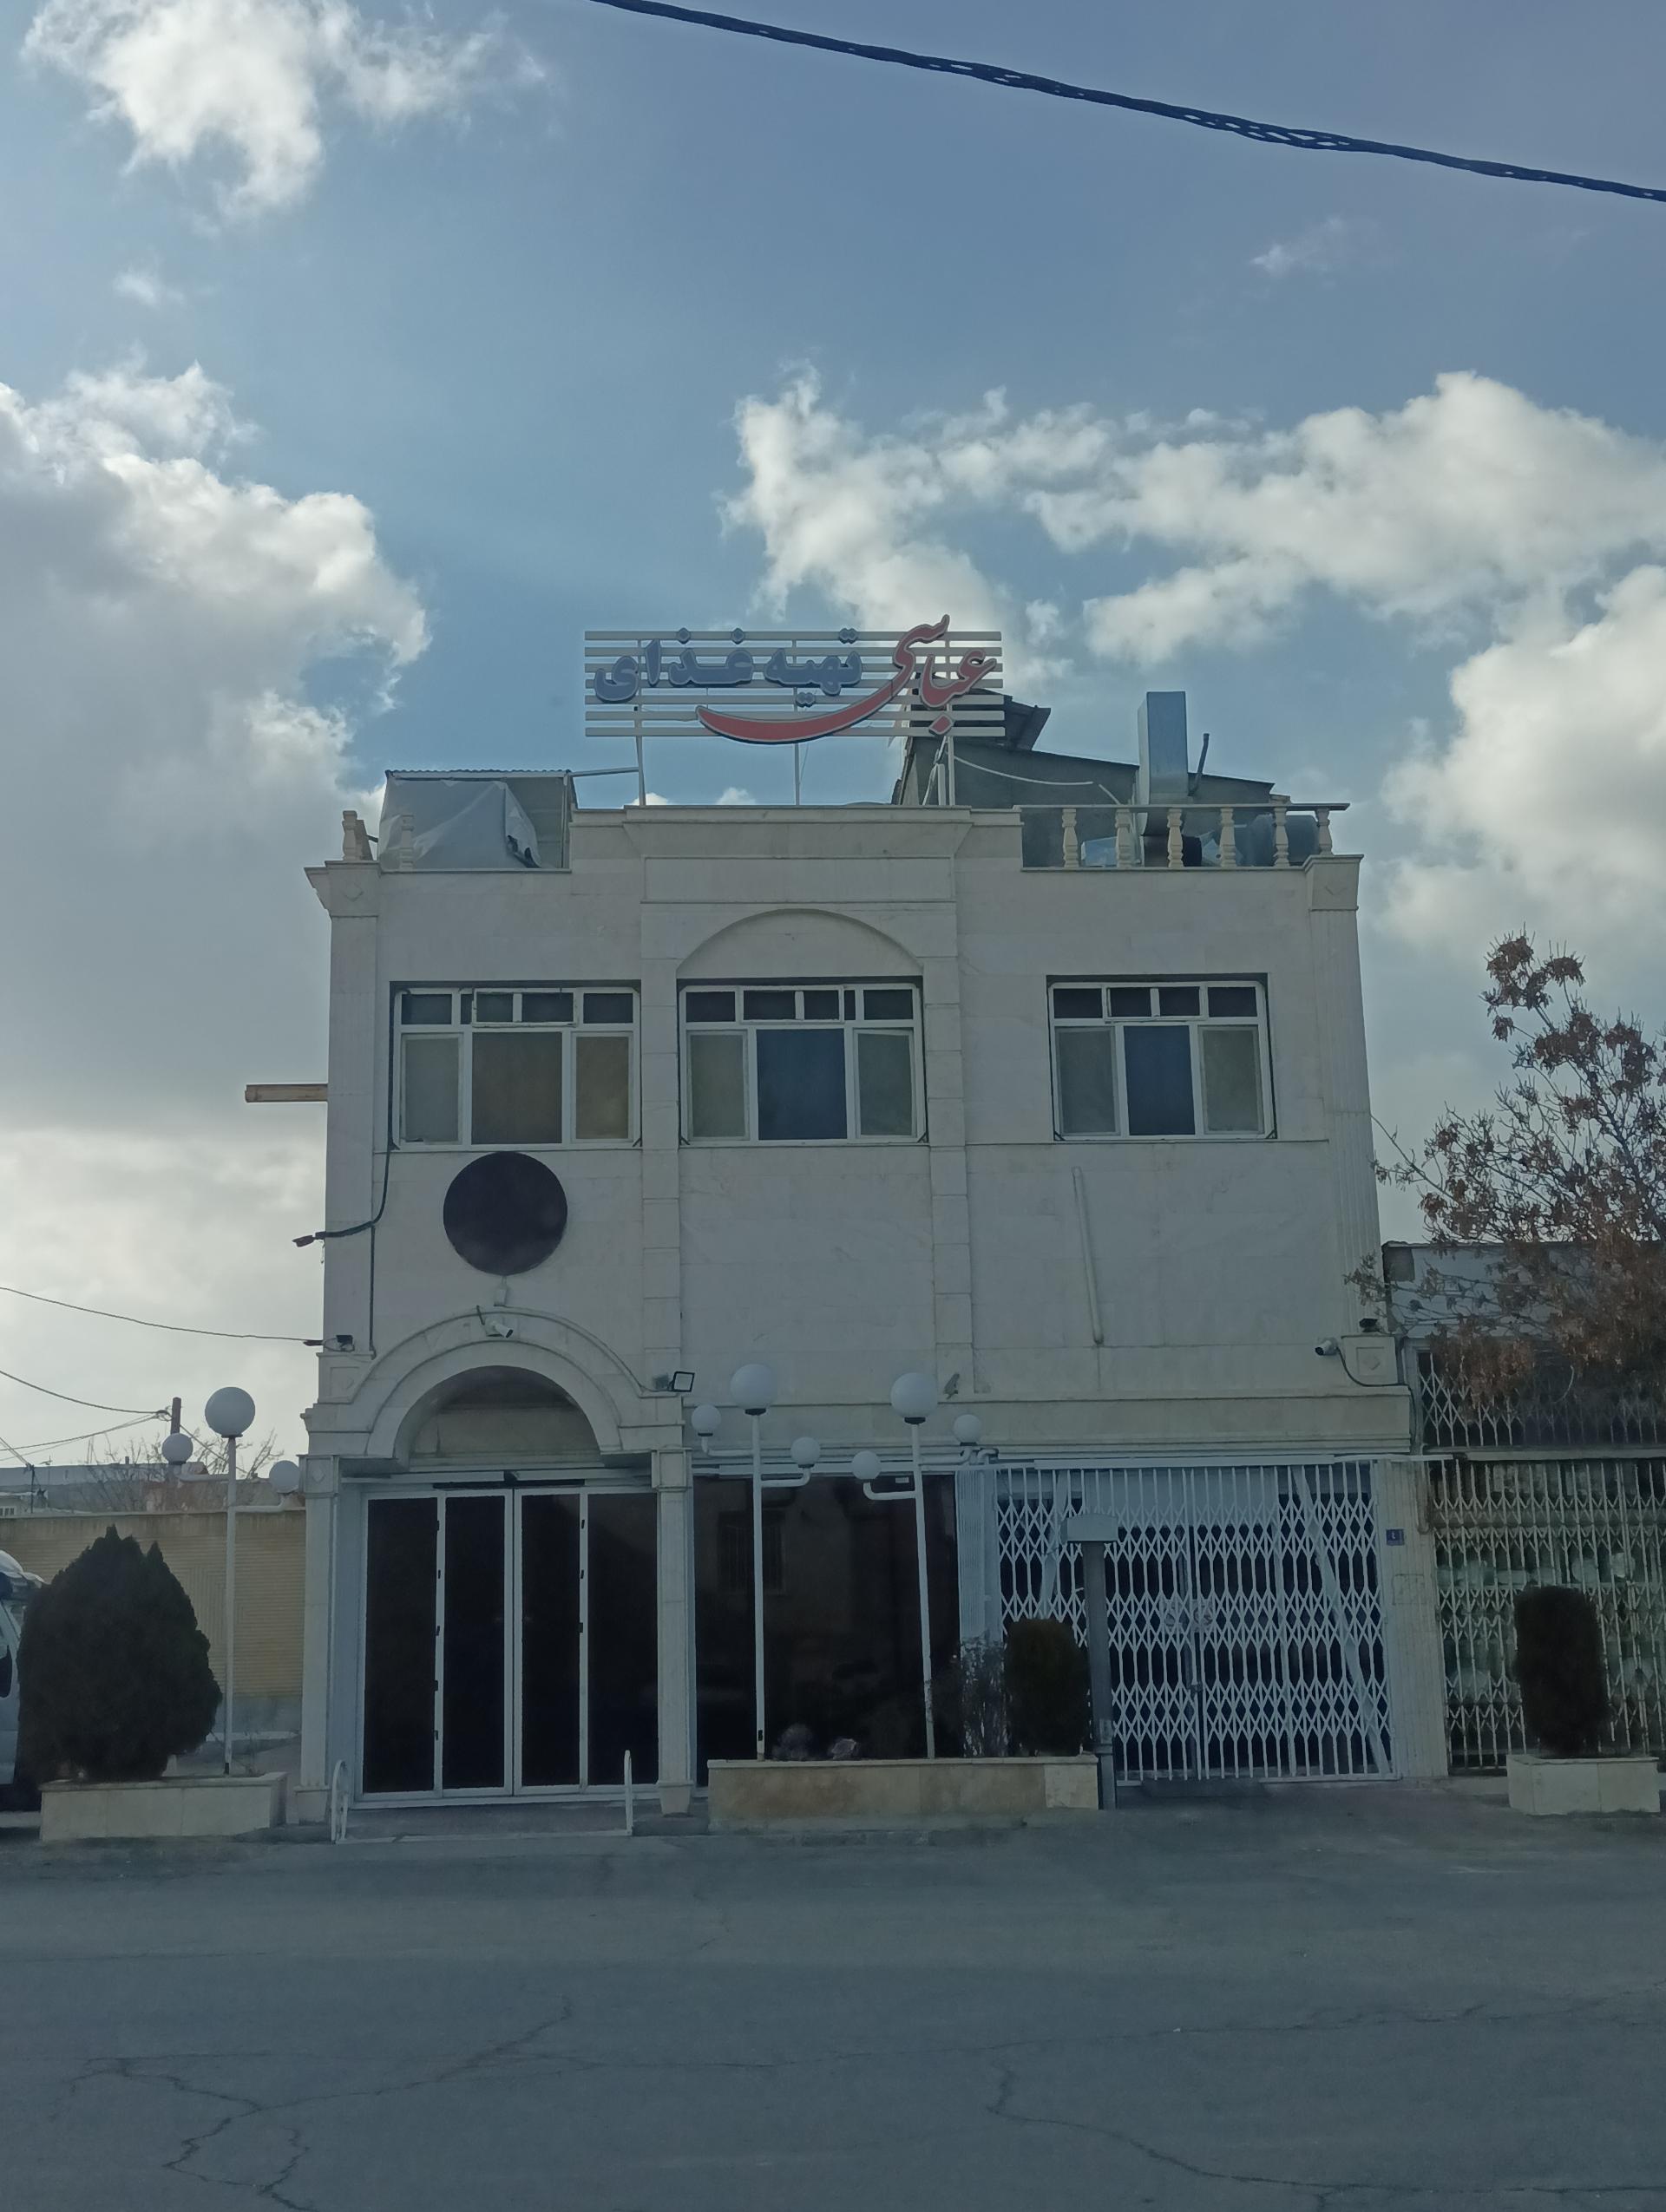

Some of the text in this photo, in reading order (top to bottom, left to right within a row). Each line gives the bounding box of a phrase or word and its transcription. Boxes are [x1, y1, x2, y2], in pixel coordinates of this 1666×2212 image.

[594, 614, 998, 744] تهیه غذای عباسی
